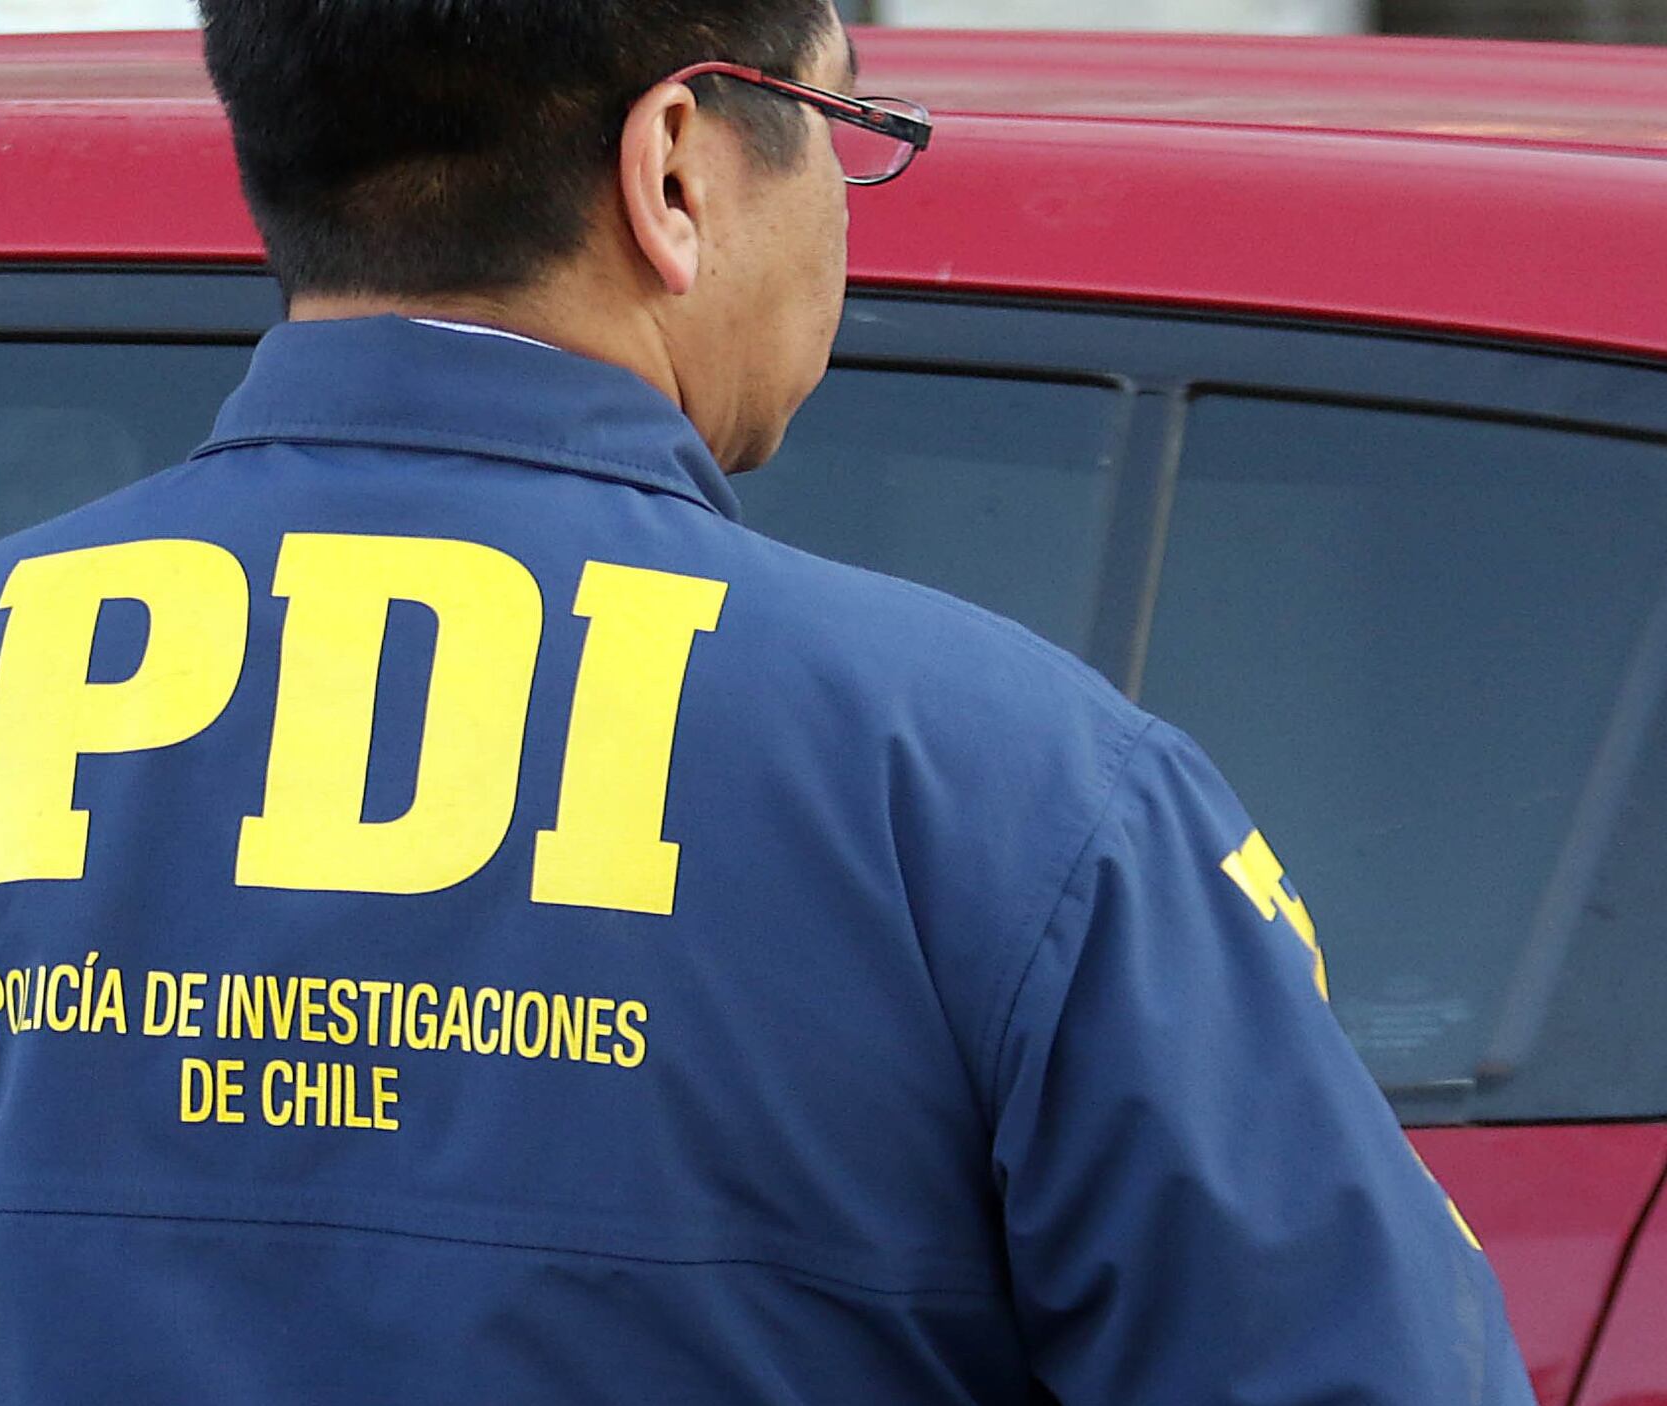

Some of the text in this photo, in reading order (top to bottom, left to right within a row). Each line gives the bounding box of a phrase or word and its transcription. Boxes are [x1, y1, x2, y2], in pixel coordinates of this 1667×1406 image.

[143, 970, 208, 1037] DE
[216, 975, 648, 1068] INVESTIGACIONES
[180, 1057, 400, 1131] DE CHILE
